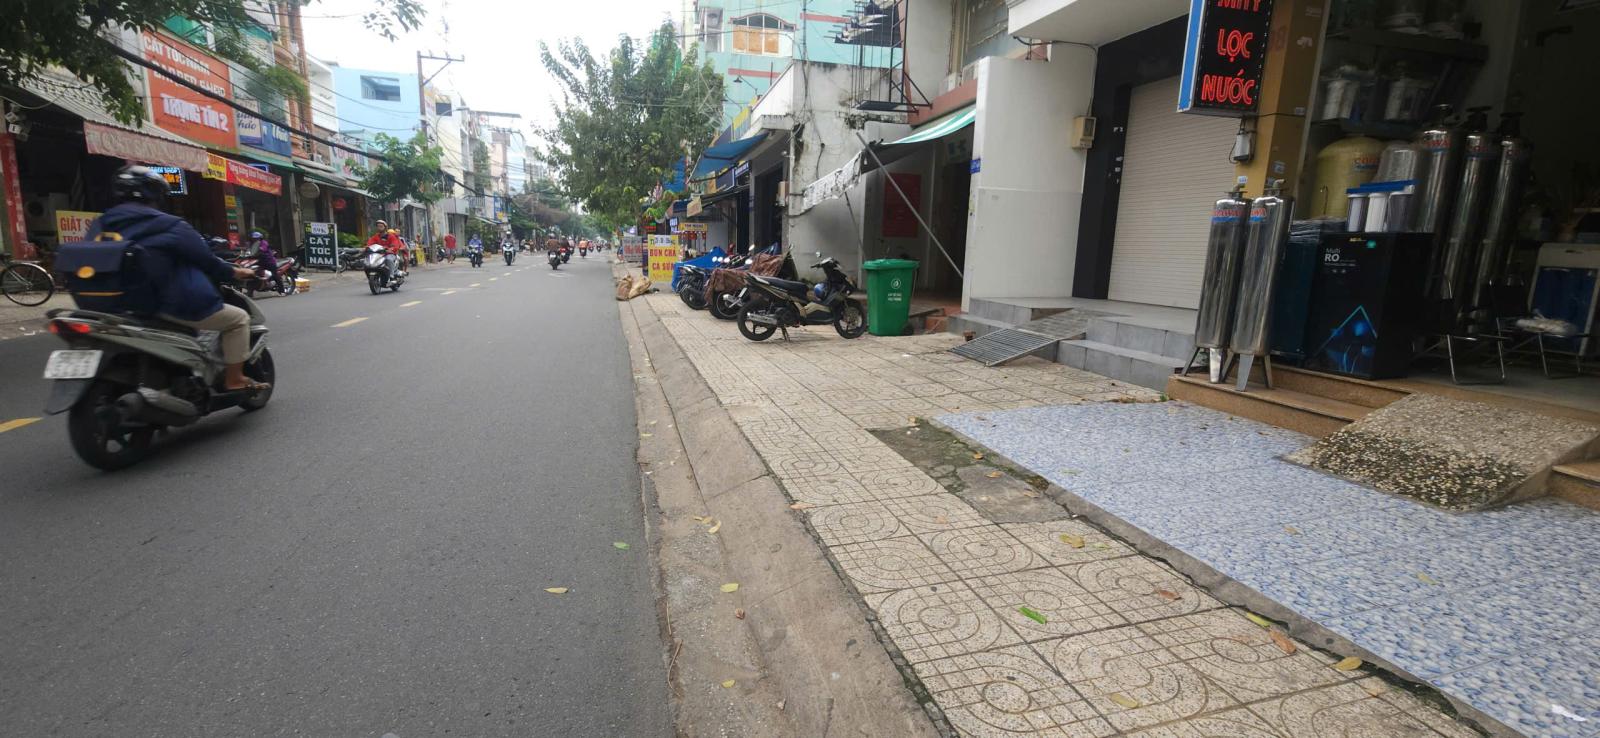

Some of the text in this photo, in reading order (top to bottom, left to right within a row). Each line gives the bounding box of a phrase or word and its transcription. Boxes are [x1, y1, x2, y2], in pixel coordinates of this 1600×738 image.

[1217, 28, 1254, 62] LỌC
[219, 112, 230, 132] 2
[309, 256, 334, 265] NAM
[1324, 253, 1340, 262] RO
